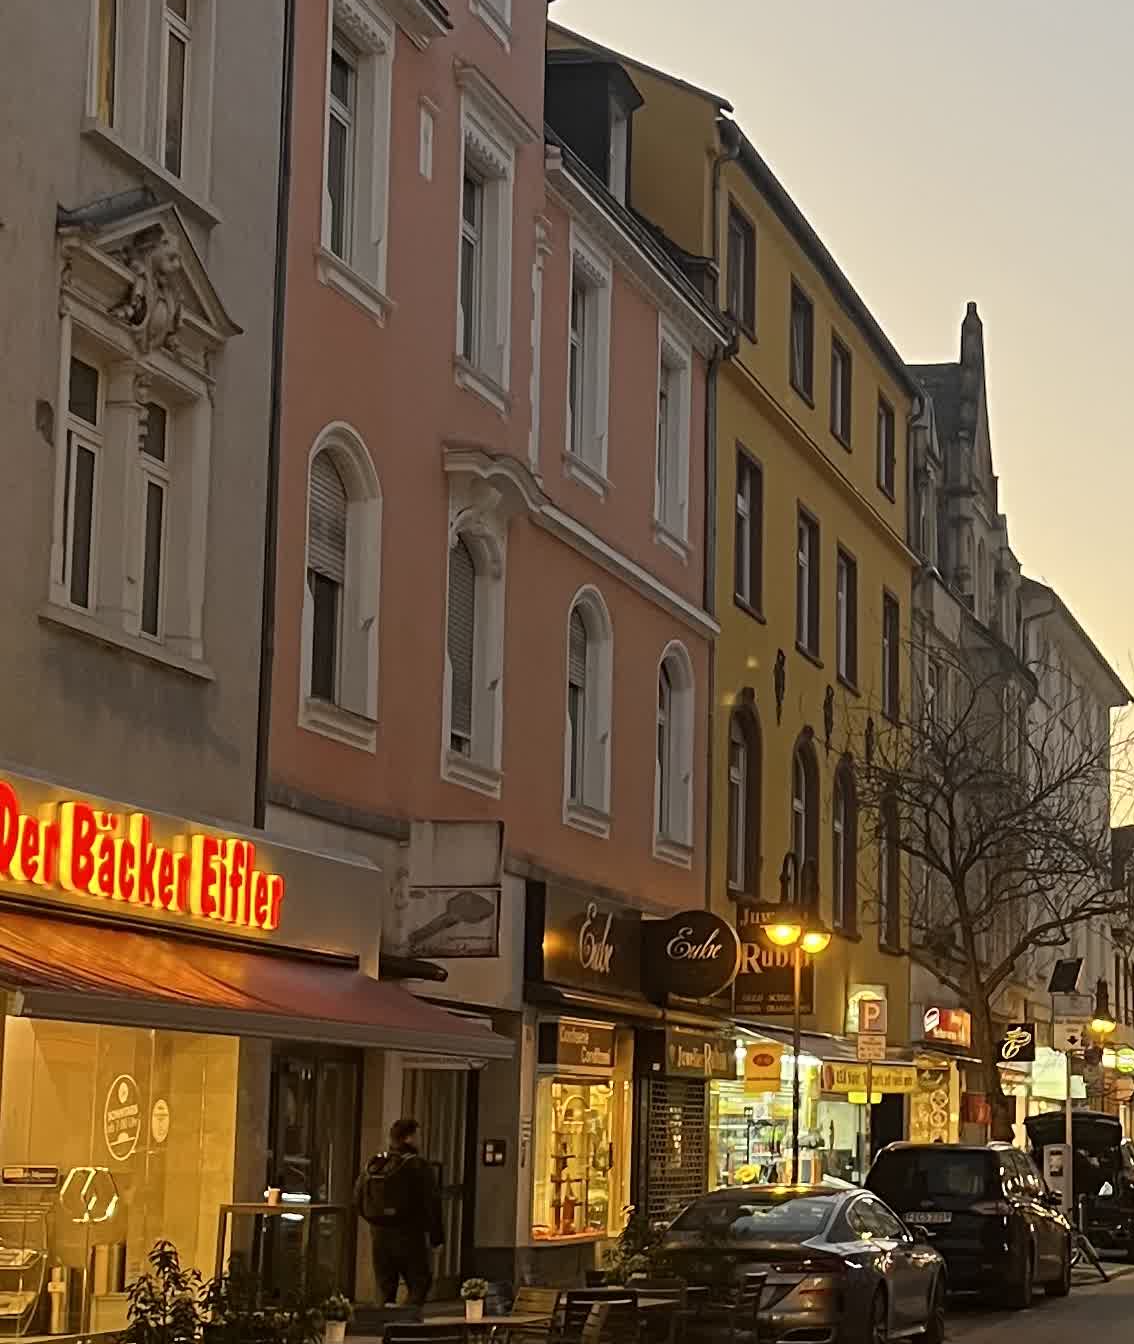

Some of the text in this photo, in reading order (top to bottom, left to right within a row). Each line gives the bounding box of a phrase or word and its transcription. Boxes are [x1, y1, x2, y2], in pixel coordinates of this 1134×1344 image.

[60, 801, 191, 913] Bäcker
[191, 834, 285, 931] Eifler
[863, 1002, 880, 1030] P
